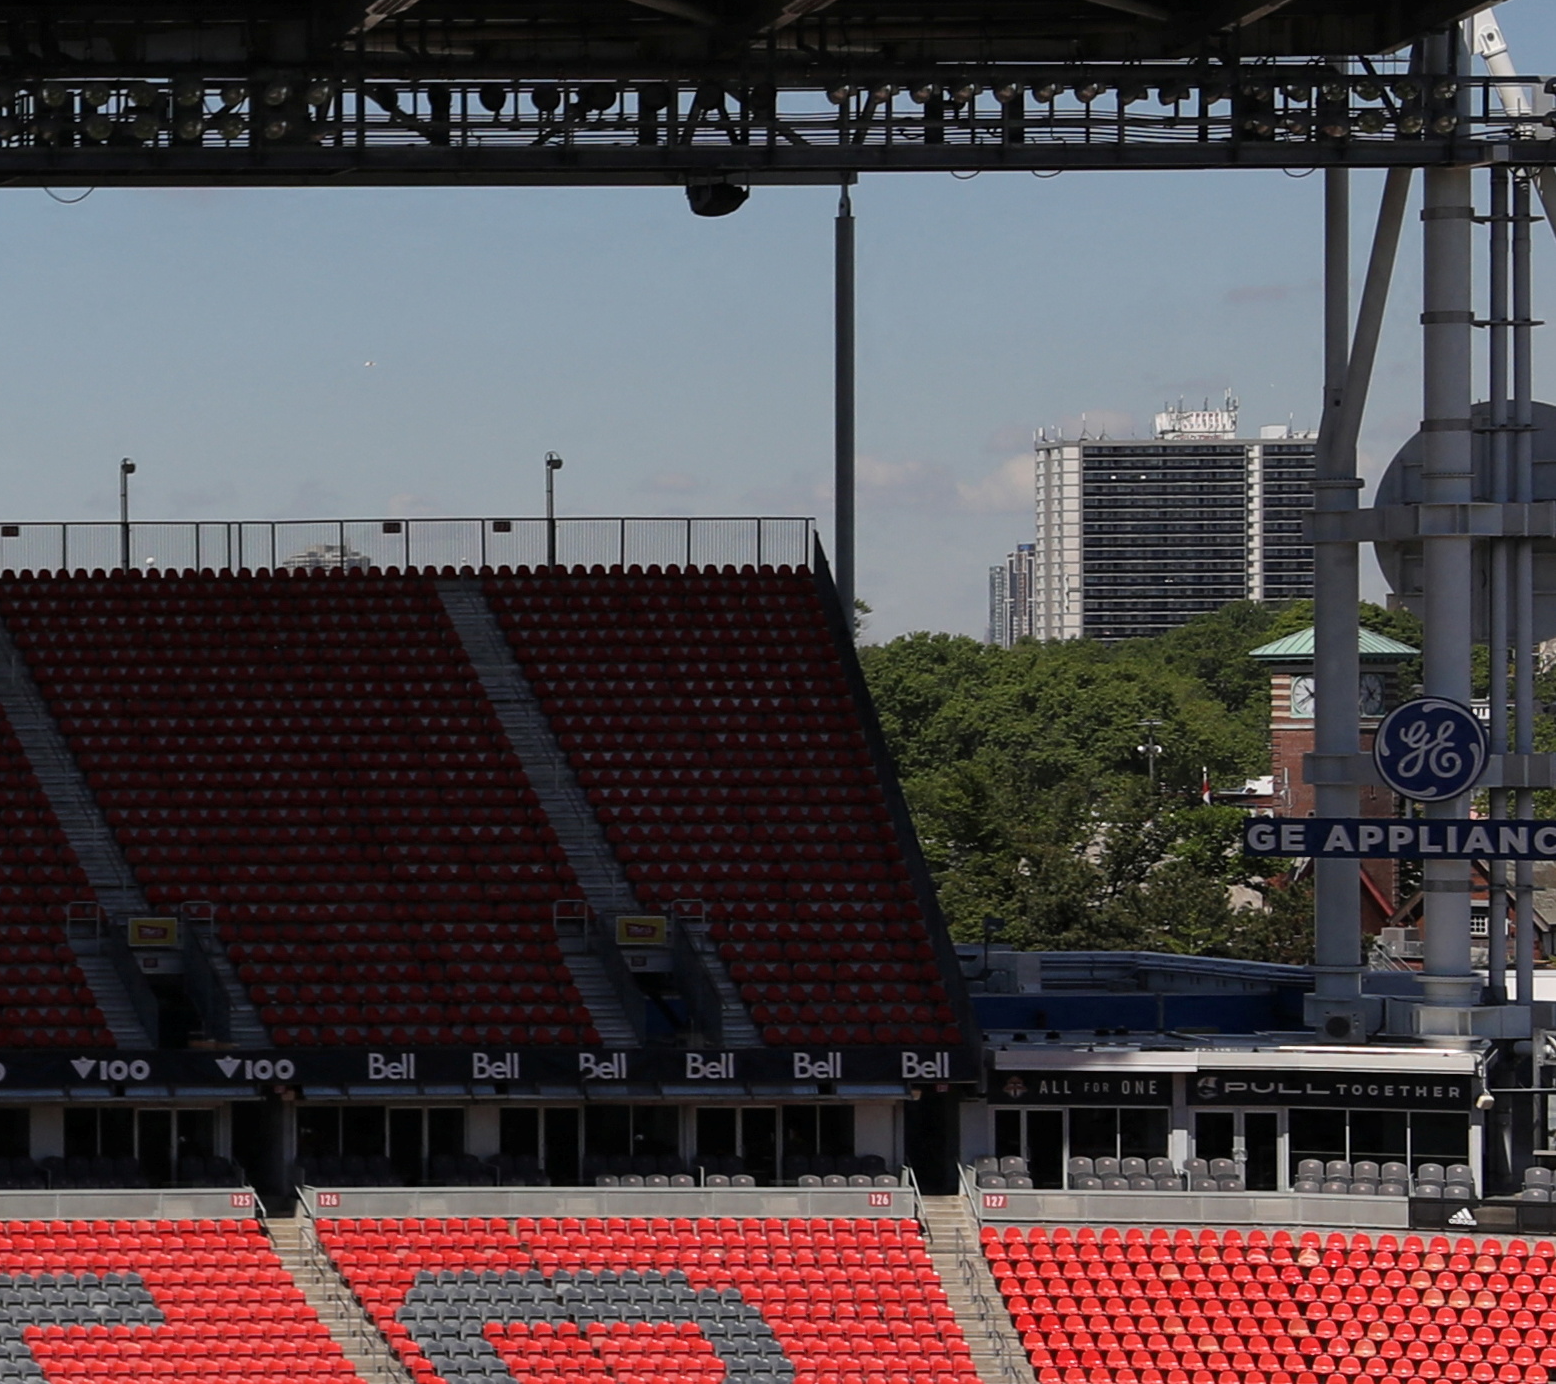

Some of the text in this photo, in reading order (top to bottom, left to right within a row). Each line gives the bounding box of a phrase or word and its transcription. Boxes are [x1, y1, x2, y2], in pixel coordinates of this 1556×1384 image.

[1246, 823, 1306, 852] GE
[99, 1059, 151, 1081] 100
[245, 1059, 295, 1081] 100
[368, 1052, 415, 1079] Bell
[472, 1052, 520, 1079] Bell
[579, 1052, 627, 1079] Bell
[686, 1052, 734, 1079] Bell
[793, 1052, 842, 1079] Bell
[901, 1052, 950, 1079] Bell
[1039, 1079, 1158, 1095] ALL FOR ONE
[1224, 1081, 1461, 1099] PULL TOGETHER
[233, 1194, 250, 1206] 125
[320, 1194, 338, 1205] 126
[871, 1193, 888, 1205] 126
[986, 1195, 1003, 1207] 127
